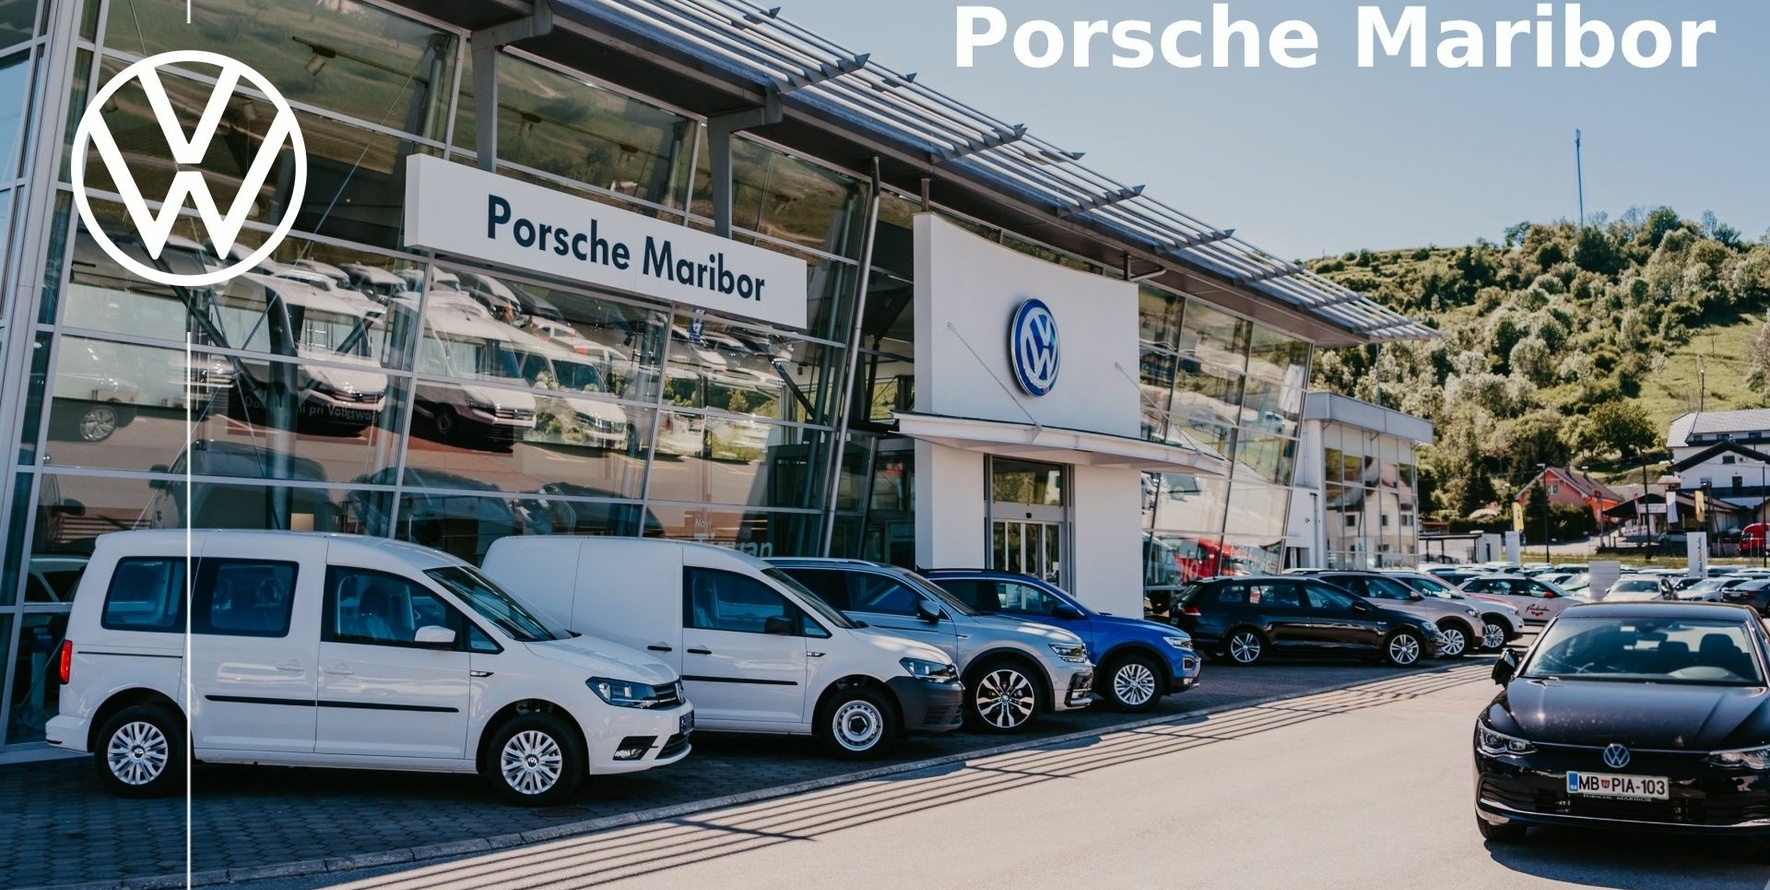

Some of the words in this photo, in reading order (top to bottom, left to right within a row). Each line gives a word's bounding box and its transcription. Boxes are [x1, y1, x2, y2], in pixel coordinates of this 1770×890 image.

[487, 194, 630, 270] Porsche
[643, 236, 765, 302] Maribor
[1579, 776, 1600, 791] MB
[1611, 778, 1665, 795] PIA-103
